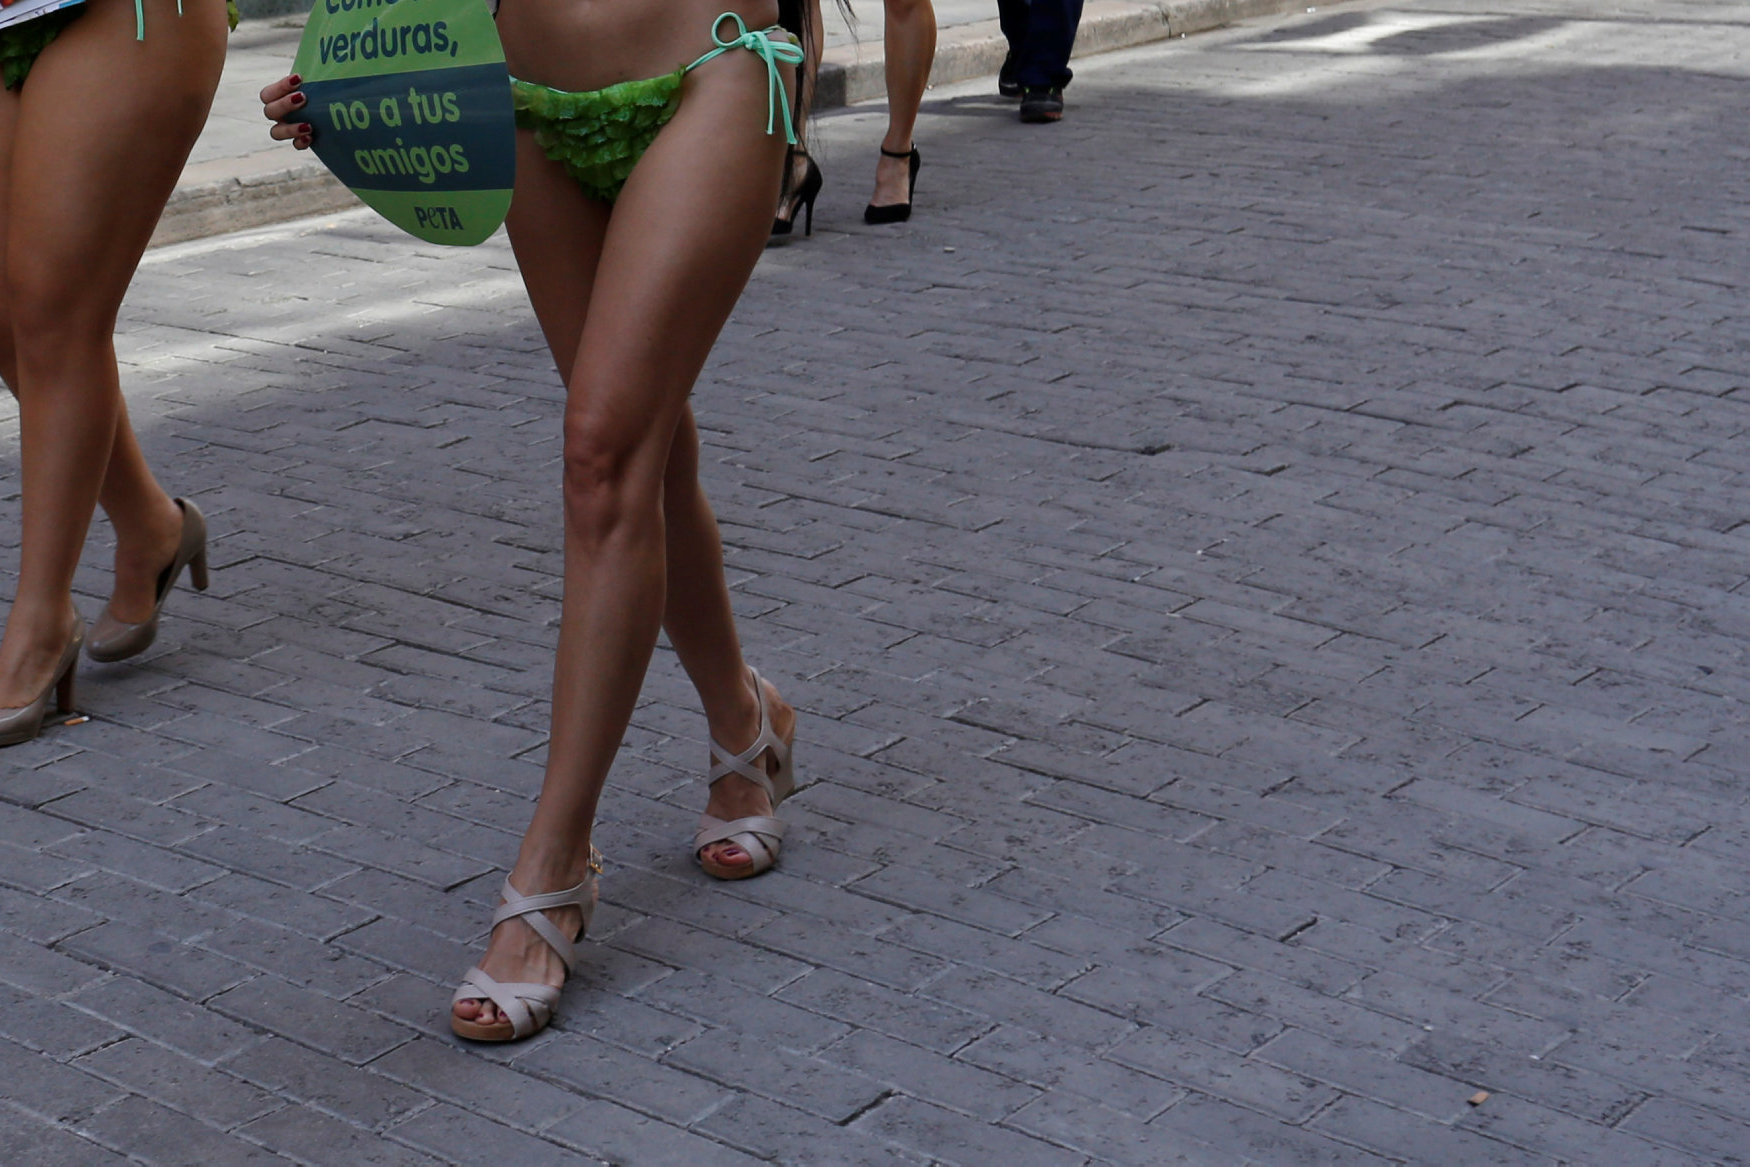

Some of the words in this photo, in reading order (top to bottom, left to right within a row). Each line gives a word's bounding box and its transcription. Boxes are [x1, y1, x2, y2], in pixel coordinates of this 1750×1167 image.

[319, 17, 459, 65] verduras,
[329, 100, 371, 131] no
[379, 97, 402, 127] a
[407, 87, 461, 125] tus
[354, 137, 470, 185] amigos
